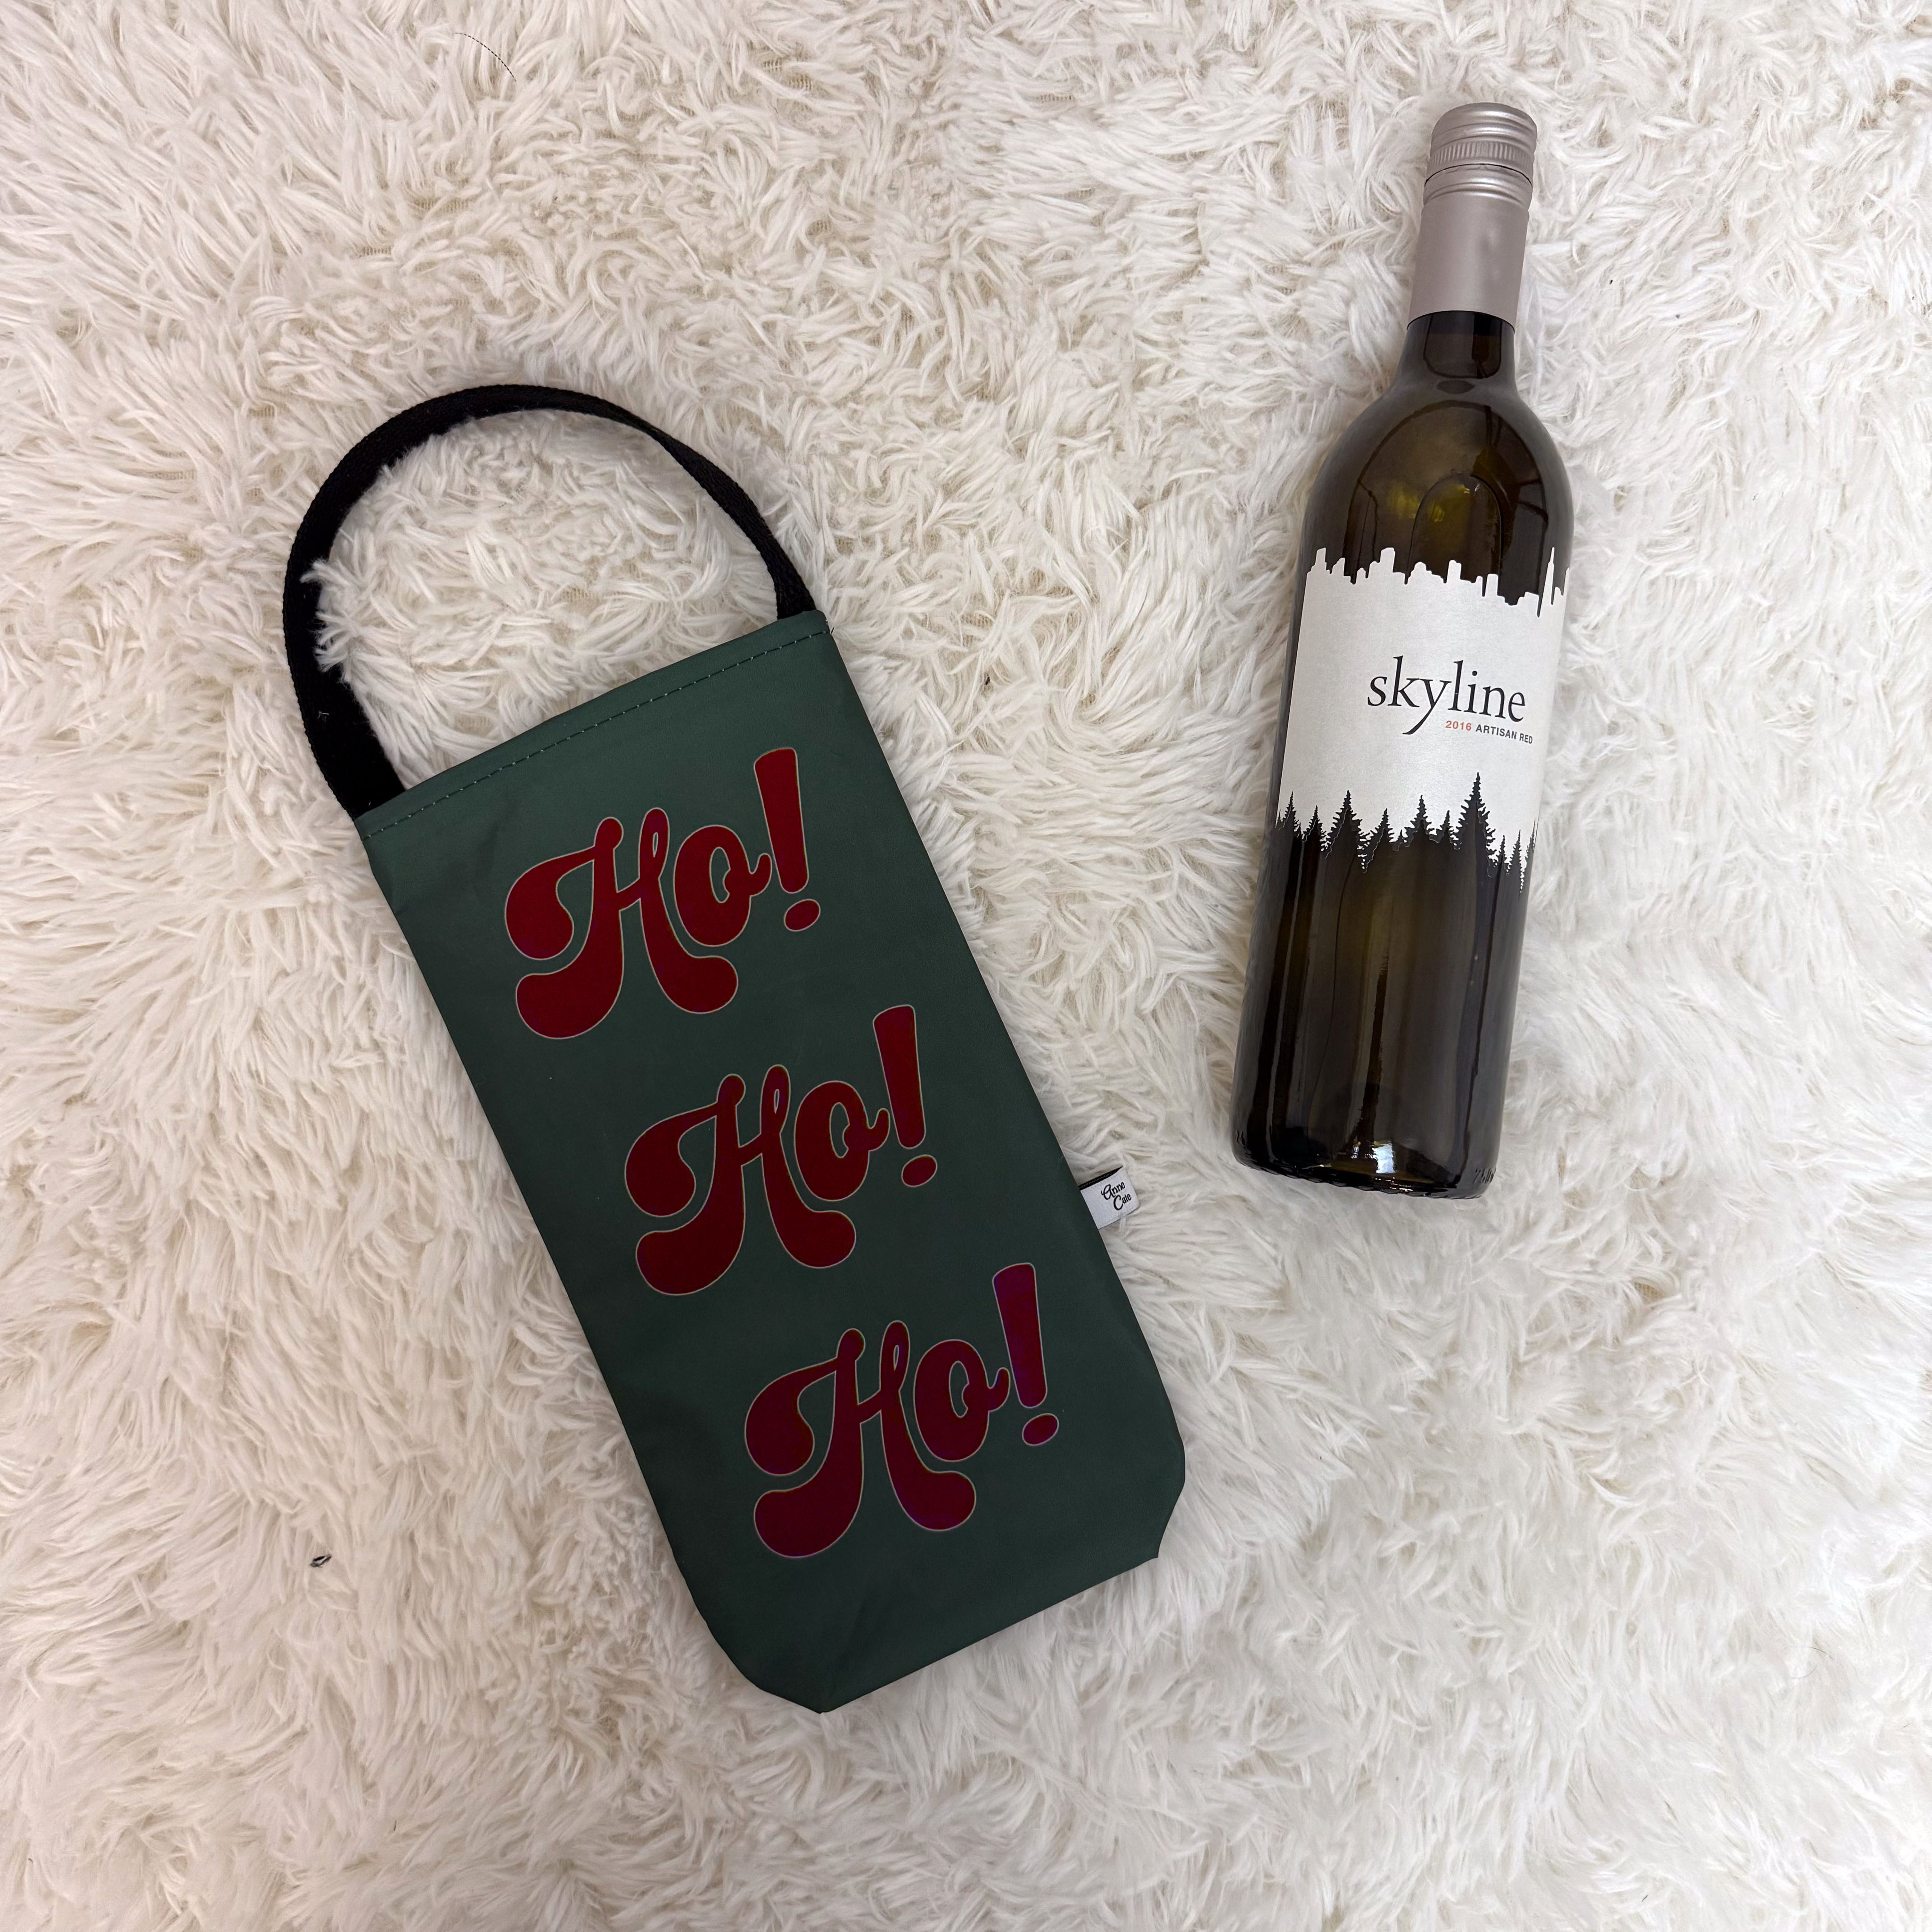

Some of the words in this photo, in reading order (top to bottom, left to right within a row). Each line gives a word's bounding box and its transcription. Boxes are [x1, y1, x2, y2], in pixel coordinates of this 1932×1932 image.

[1367, 655, 1526, 735] skyline
[1445, 720, 1472, 731] 2016
[1475, 724, 1517, 739] ARTISAN
[1519, 733, 1533, 744] RED
[505, 747, 821, 1039] Ho!
[625, 1005, 937, 1295] Ho!
[1101, 1182, 1125, 1200] Anne
[745, 1262, 1059, 1558] Ho!
